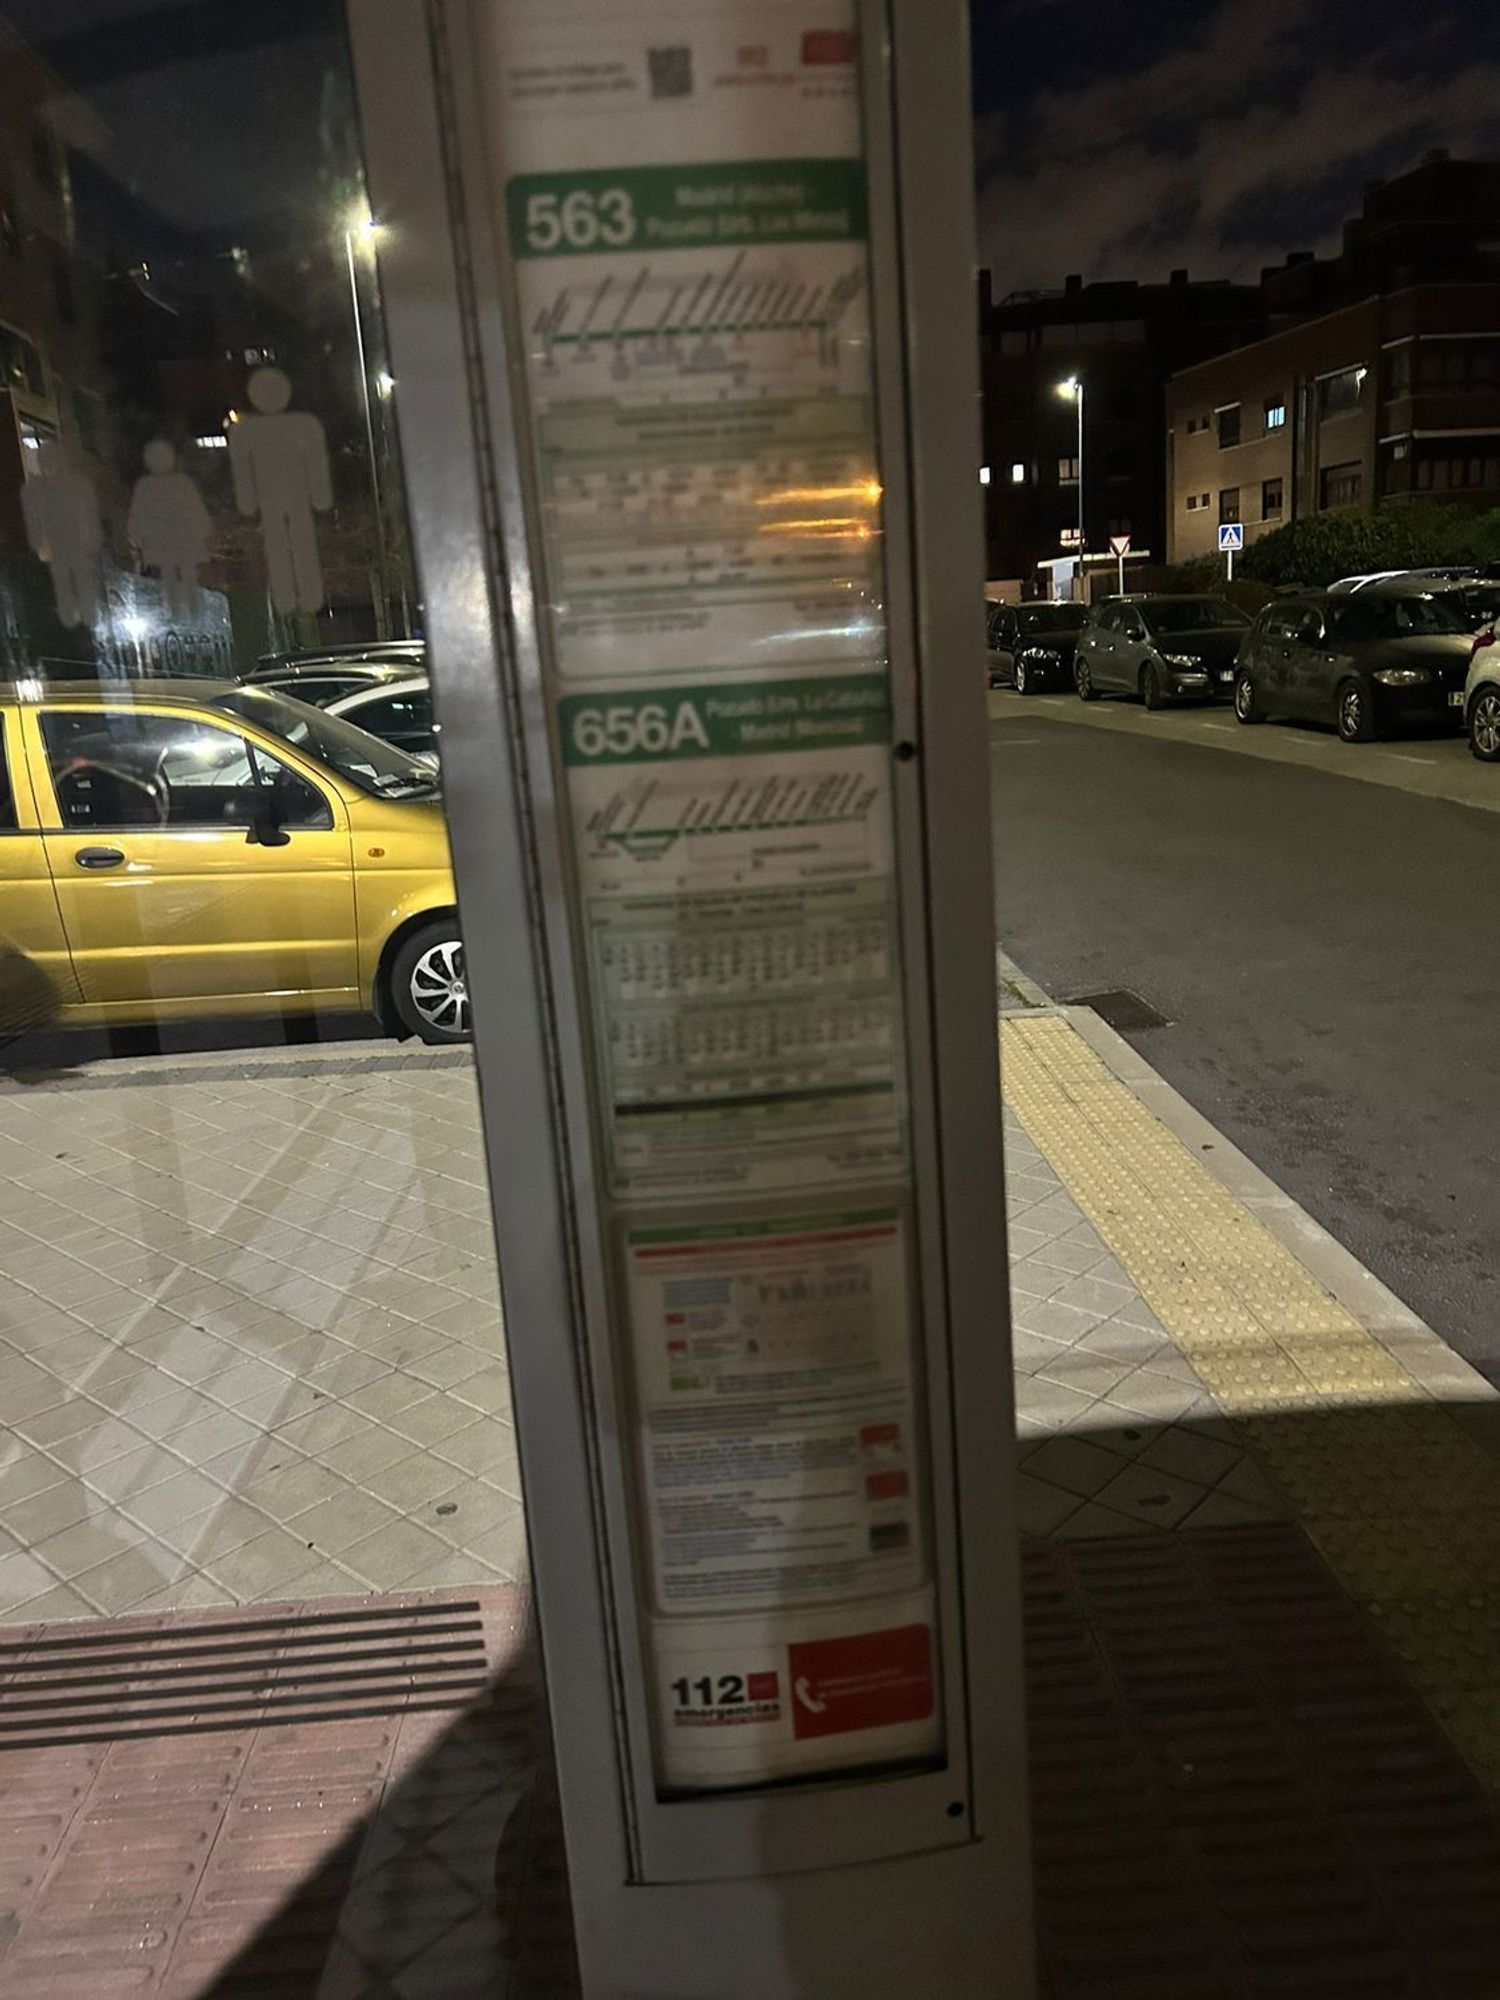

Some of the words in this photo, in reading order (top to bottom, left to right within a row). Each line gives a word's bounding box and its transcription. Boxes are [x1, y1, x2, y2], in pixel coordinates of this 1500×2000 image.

[526, 188, 637, 250] 563
[572, 702, 710, 756] 656A
[671, 1675, 745, 1706] 112
